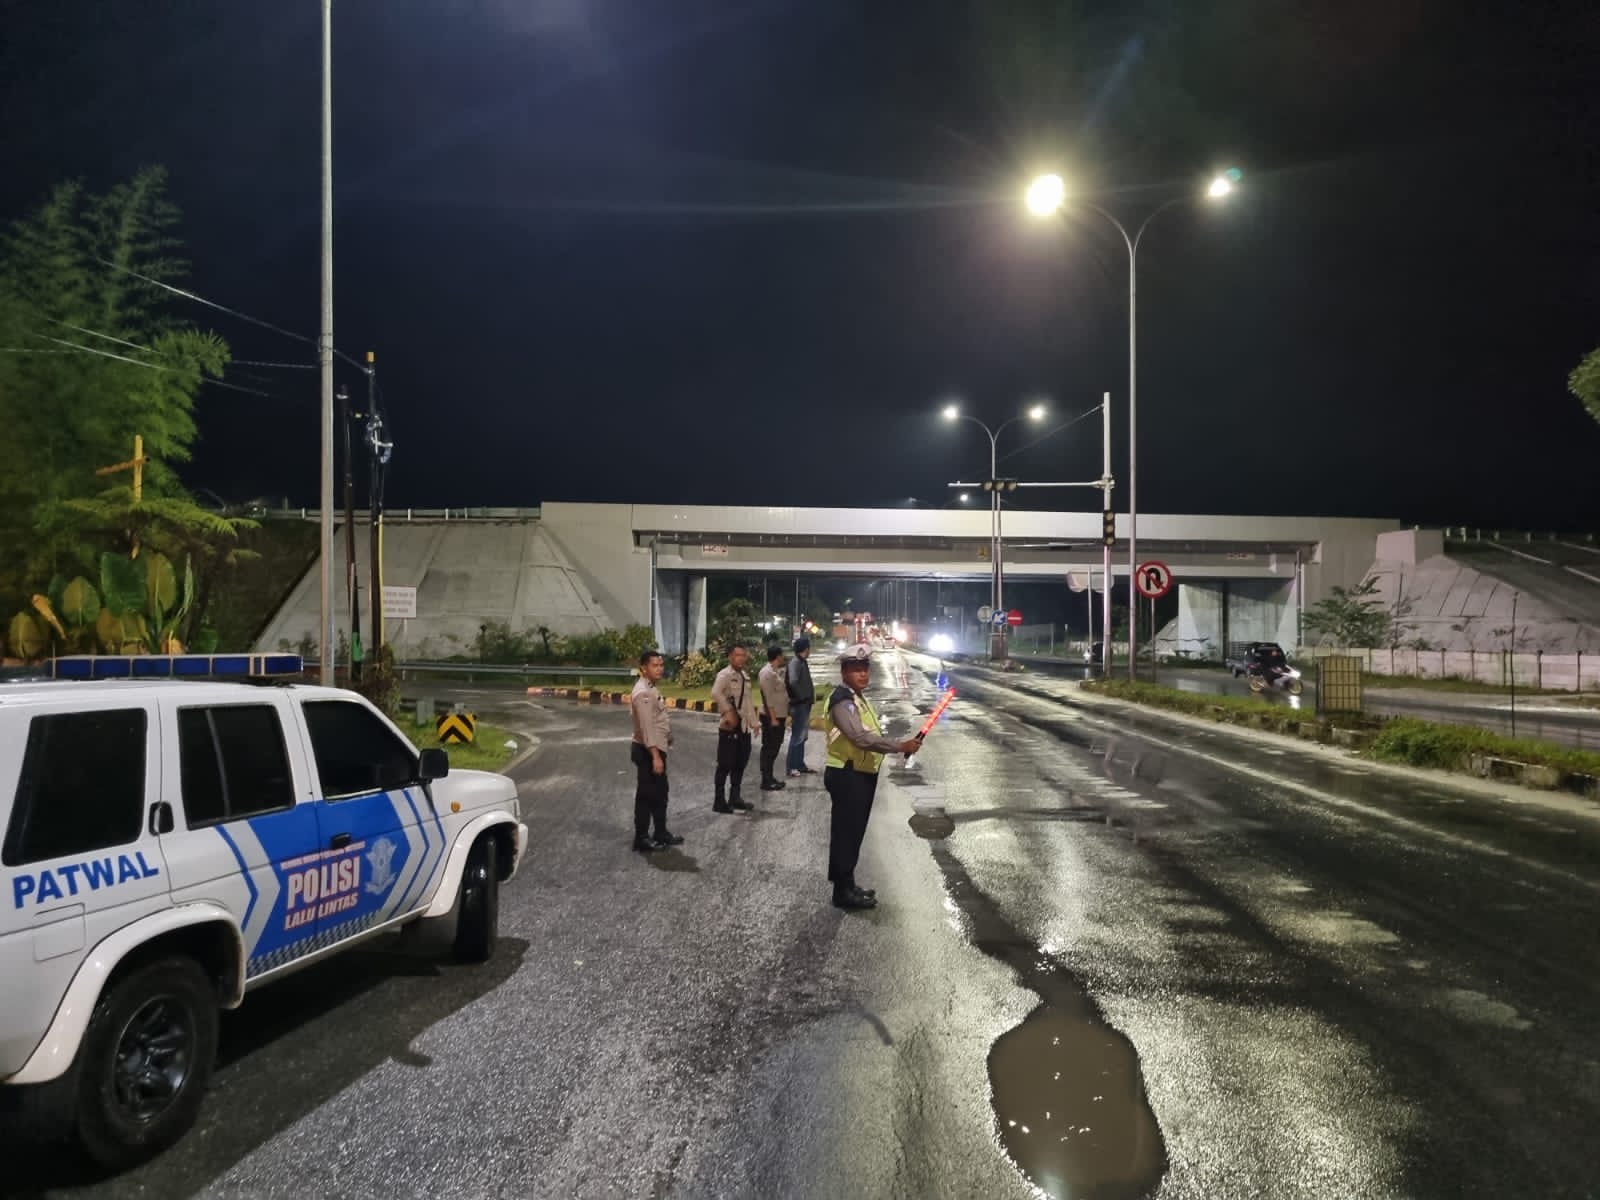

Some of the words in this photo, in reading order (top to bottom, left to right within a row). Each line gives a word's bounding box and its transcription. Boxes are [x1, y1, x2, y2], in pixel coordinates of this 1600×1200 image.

[12, 851, 159, 909] PATWAL
[287, 856, 361, 909] POLISI
[284, 905, 316, 930] LALU
[318, 892, 359, 918] LINTAS
